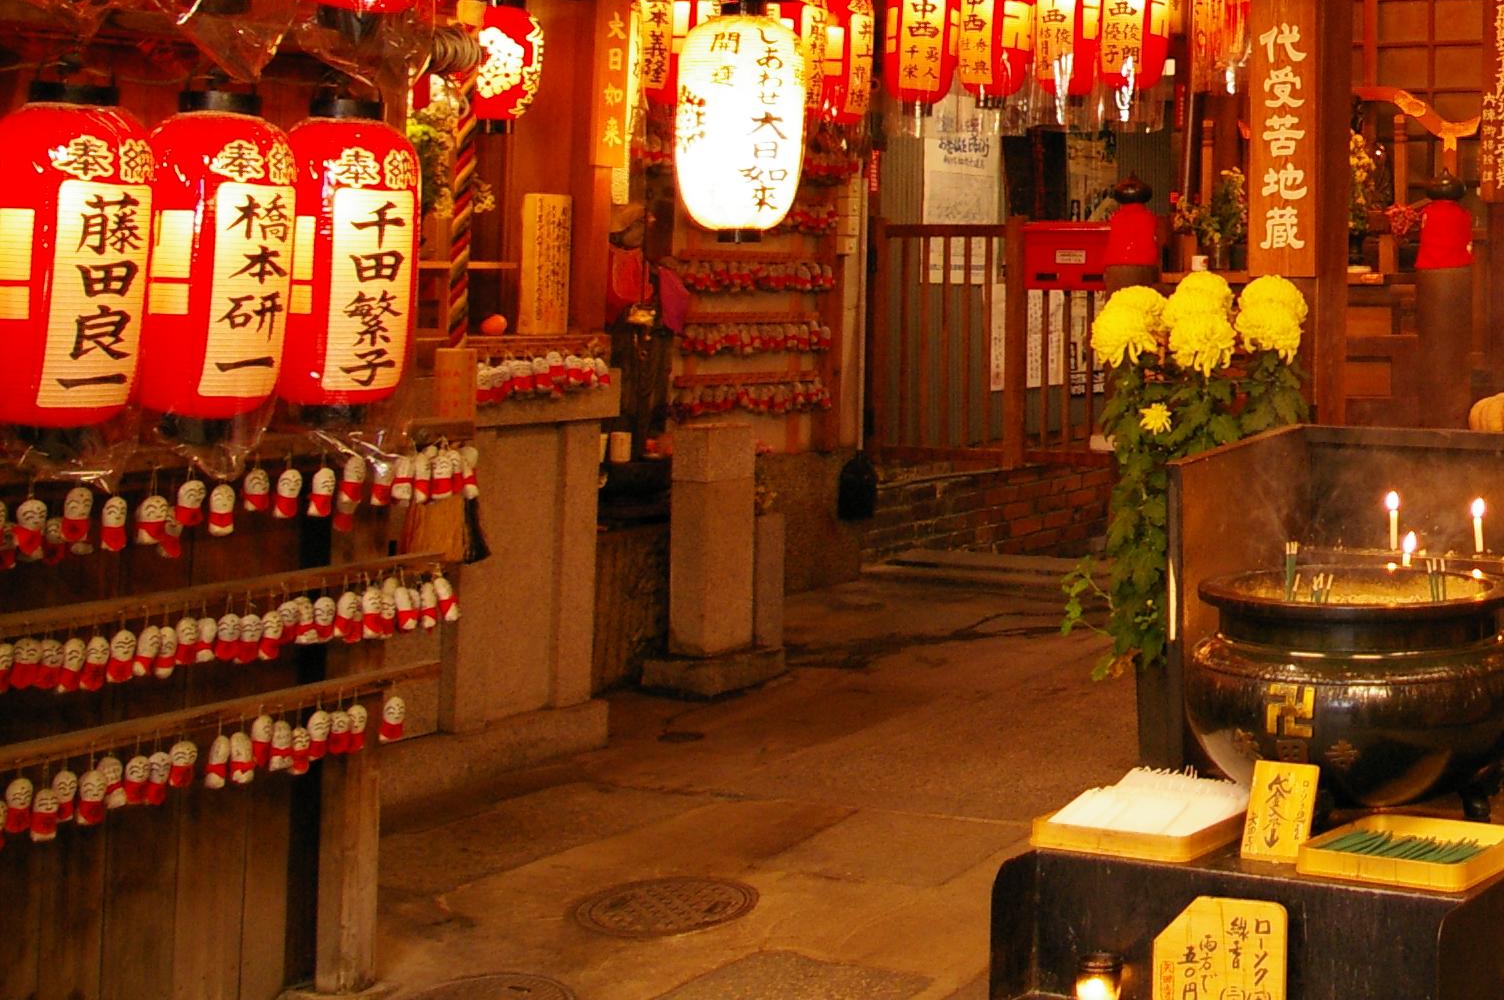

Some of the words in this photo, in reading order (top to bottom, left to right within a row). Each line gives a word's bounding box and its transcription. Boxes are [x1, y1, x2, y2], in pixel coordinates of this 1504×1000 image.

[48, 133, 154, 182] 奉納
[606, 11, 627, 148] 大日如来
[1259, 23, 1307, 251] 代受苦地蔵
[210, 139, 298, 185] 奉納
[332, 146, 418, 188] 奉納
[56, 191, 145, 391] 藤田良一
[214, 193, 291, 373] 橋本研一
[340, 200, 406, 387] 千田繁子
